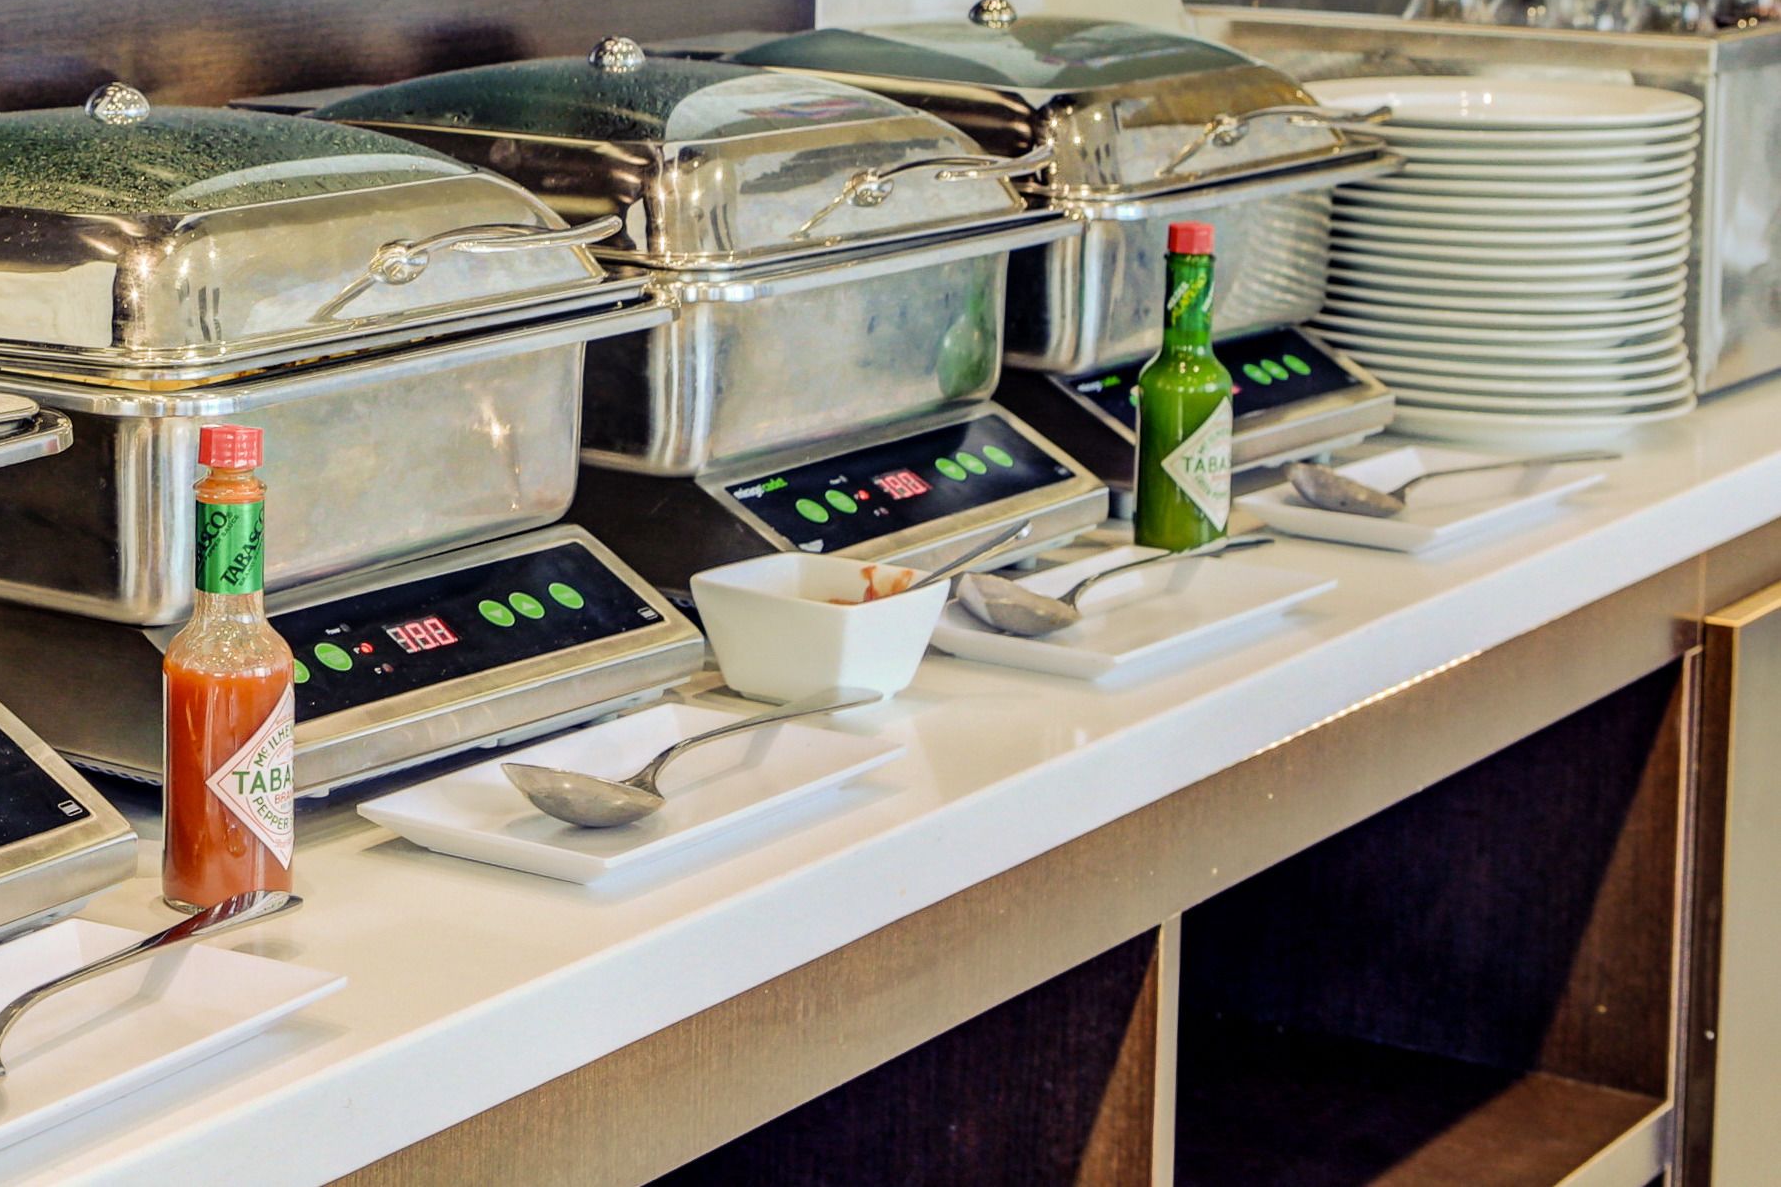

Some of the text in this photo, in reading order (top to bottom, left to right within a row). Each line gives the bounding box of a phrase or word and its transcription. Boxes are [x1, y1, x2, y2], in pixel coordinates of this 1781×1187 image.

[268, 723, 294, 750] ILHE
[232, 764, 295, 795] TABA
[252, 796, 290, 830] PEPPER
